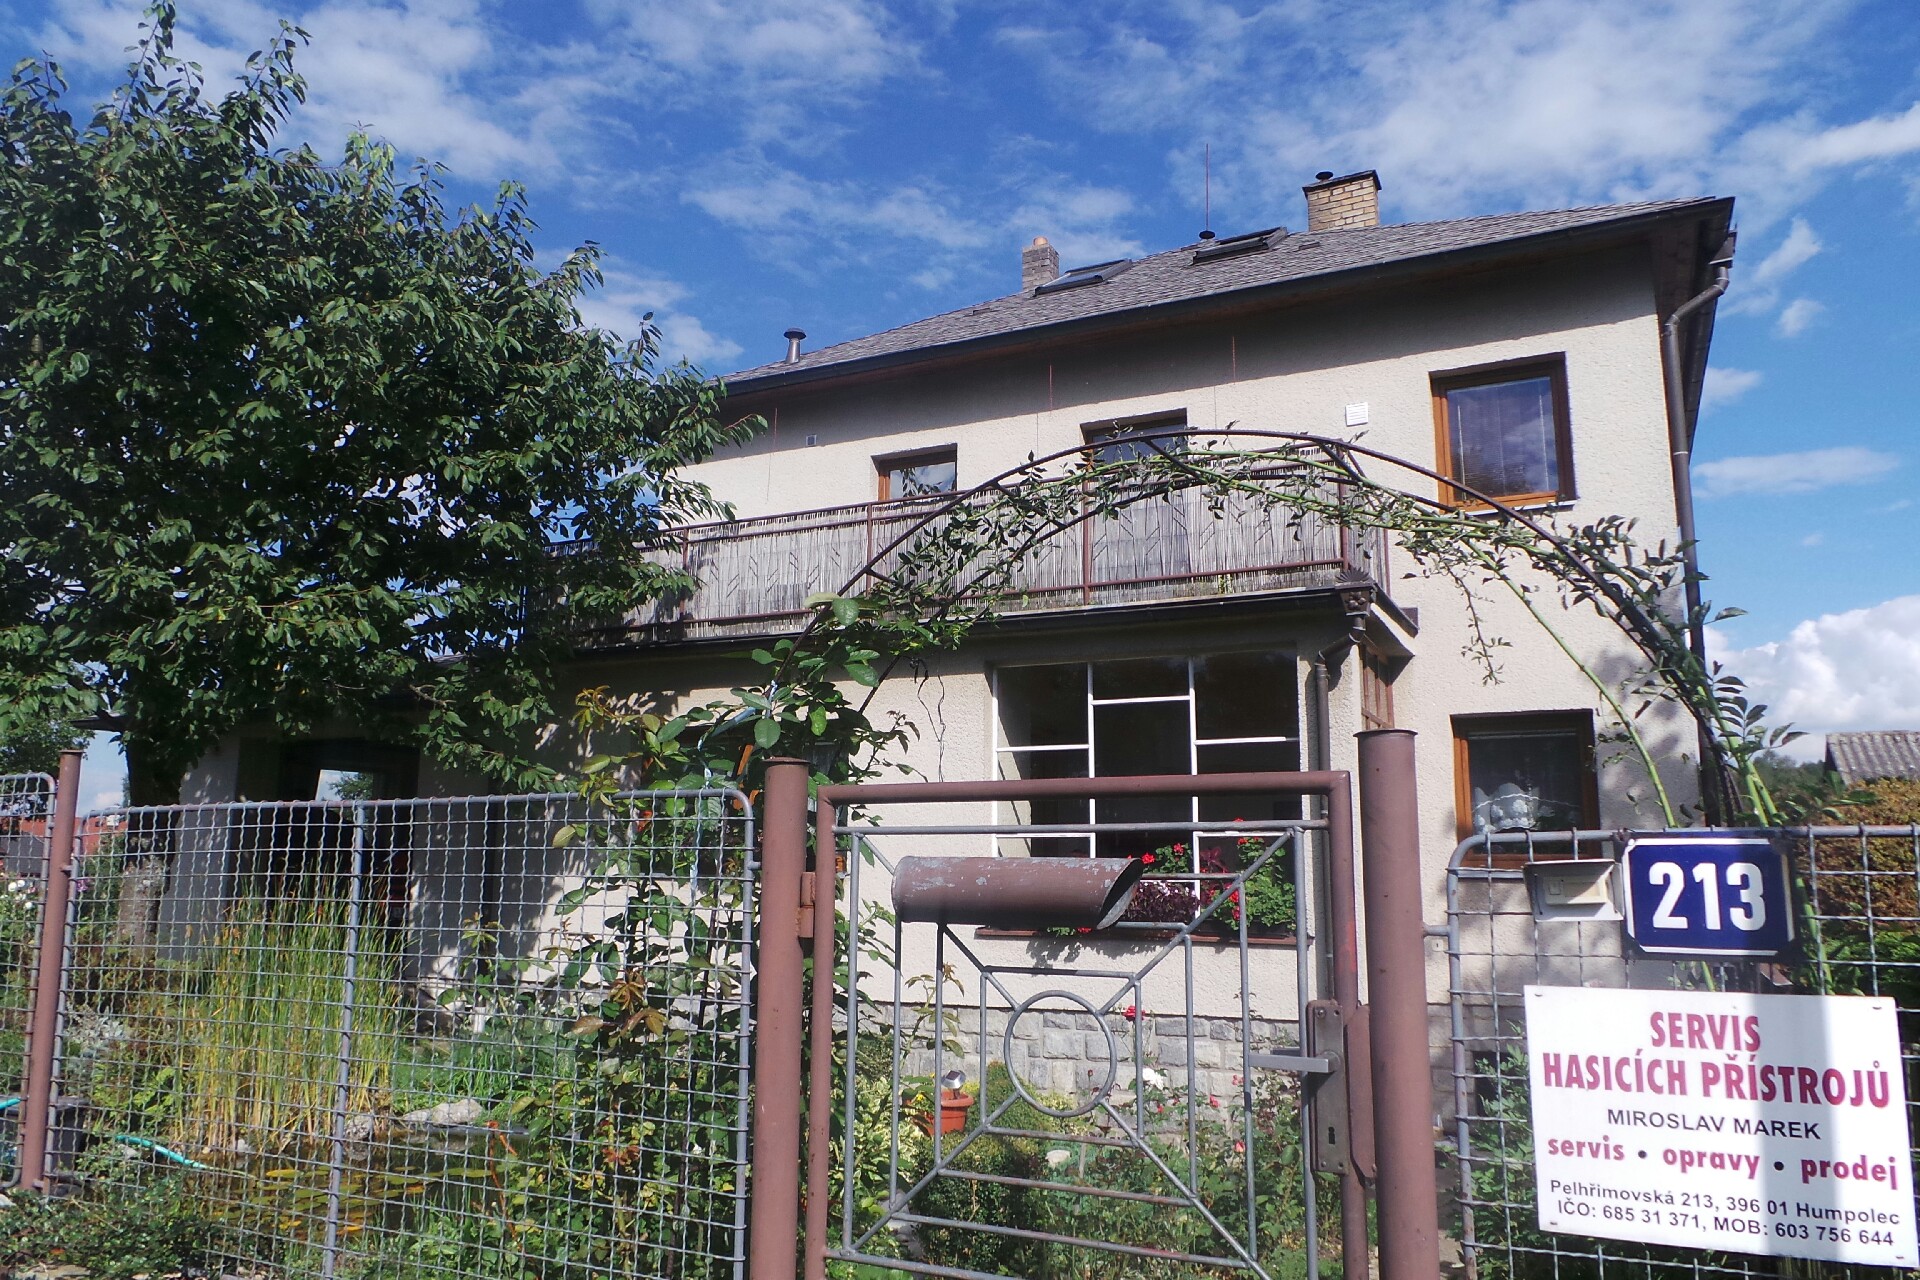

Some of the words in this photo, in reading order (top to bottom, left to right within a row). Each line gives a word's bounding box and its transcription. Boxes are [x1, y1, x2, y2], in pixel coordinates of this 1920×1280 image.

[1649, 861, 1766, 931] 213
[1650, 1011, 1760, 1051] SERVIS
[1543, 1048, 1688, 1096] HASICÍCH
[1701, 1054, 1889, 1108] PŘÍSTROJŮ
[1607, 1109, 1725, 1132] MIROSLAV
[1734, 1118, 1821, 1140] MAREK
[1548, 1135, 1625, 1161] servis
[1662, 1148, 1760, 1179] opravy
[1801, 1155, 1898, 1190] prodej
[1551, 1180, 1674, 1205] Pelhřimovská
[1681, 1193, 1720, 1212] 213,
[1726, 1197, 1760, 1213] 396
[1767, 1200, 1789, 1216] 01
[1796, 1202, 1899, 1225] Humpolec
[1558, 1198, 1596, 1218] IČO:
[1603, 1205, 1635, 1222] 685
[1641, 1209, 1662, 1225] 31
[1669, 1211, 1707, 1232] 371,
[1714, 1217, 1768, 1235] MOB:
[1775, 1222, 1809, 1240] 603
[1816, 1226, 1851, 1243] 756
[1859, 1230, 1893, 1246] 644
